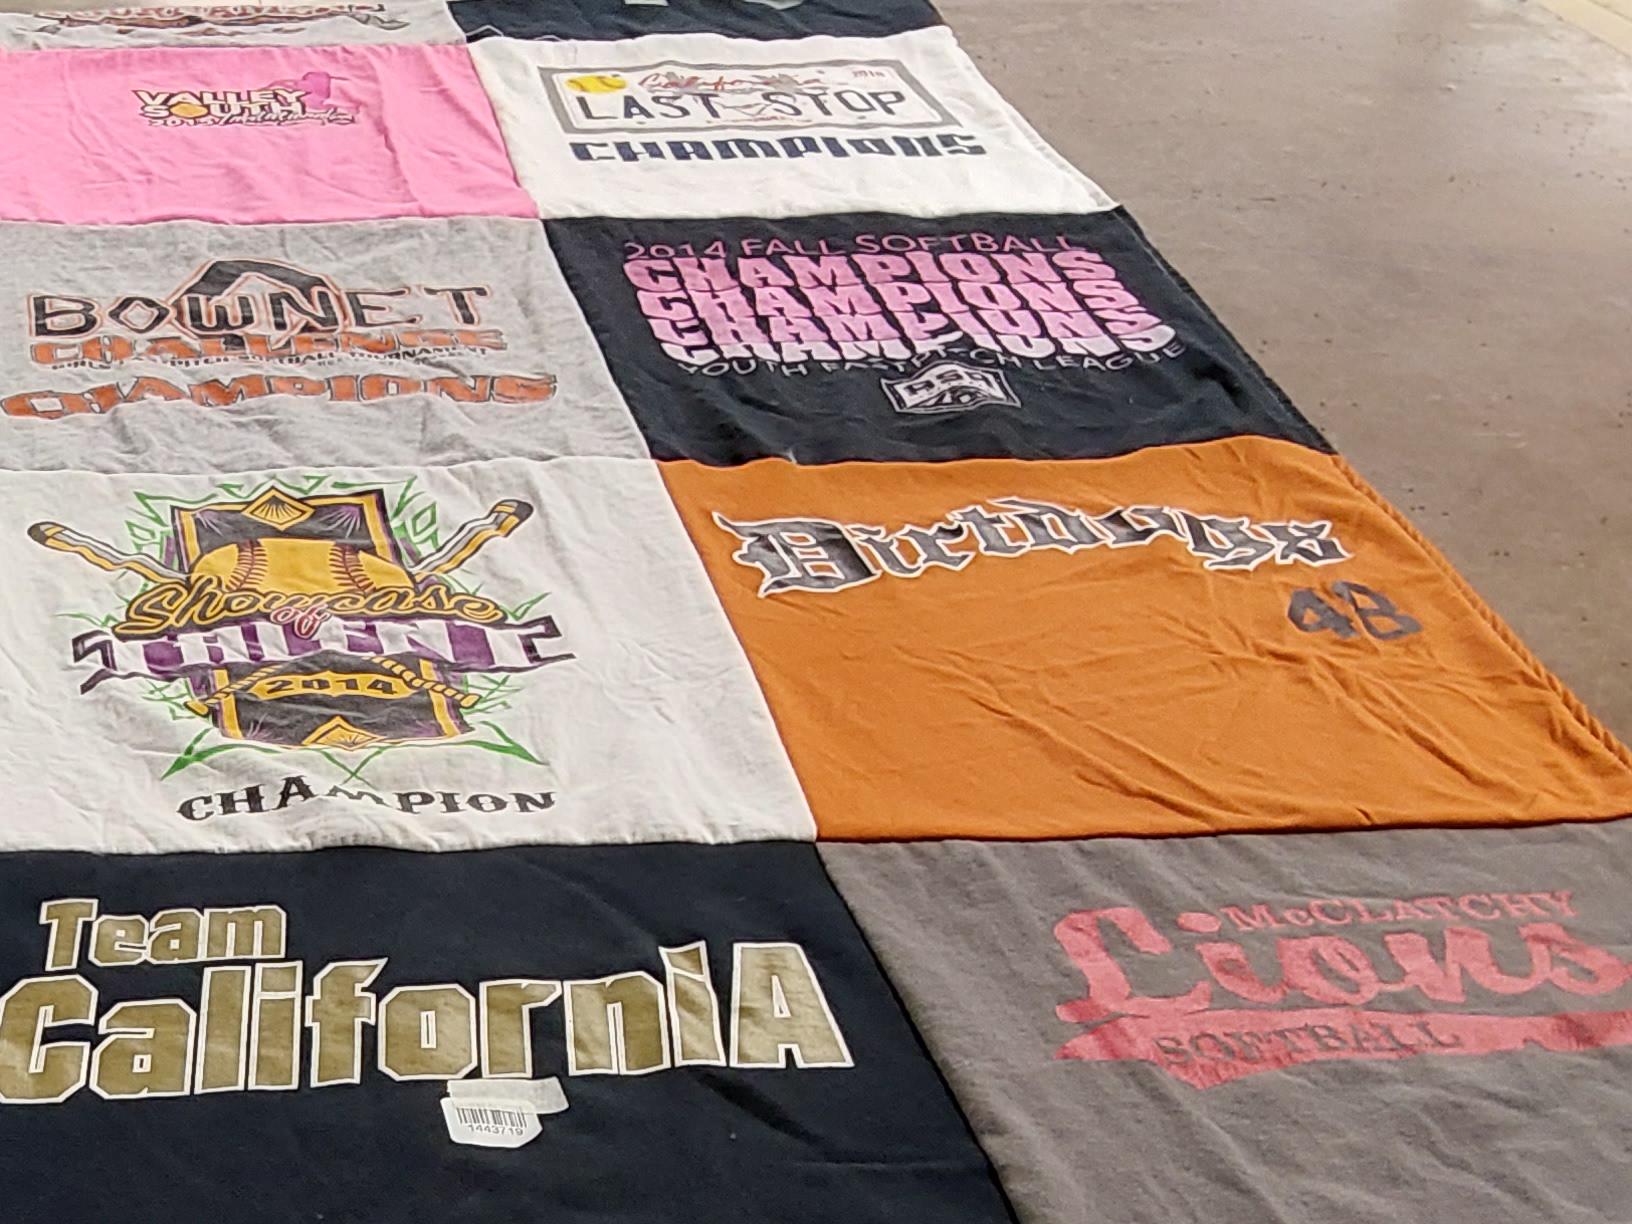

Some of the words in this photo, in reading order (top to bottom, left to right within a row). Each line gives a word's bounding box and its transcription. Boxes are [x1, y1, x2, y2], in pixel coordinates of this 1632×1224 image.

[132, 90, 309, 105] VALLEY
[575, 92, 720, 121] LAST
[764, 90, 909, 117] STOP
[569, 133, 988, 162] CHAMPIONS
[624, 240, 726, 259] 2014
[741, 237, 846, 257] FALL
[855, 232, 1086, 254] SOFTBALL
[623, 250, 1116, 292] CHAMPIONS
[29, 284, 492, 338] BOWNET
[637, 280, 1139, 320] CHAMPIONS
[1032, 341, 1186, 371] LEAGUE
[111, 571, 508, 641] Showcase
[270, 603, 339, 641] of
[1286, 580, 1424, 643] 48
[263, 678, 401, 698] 2014
[176, 774, 558, 823] CHAMPION
[1219, 889, 1582, 933] McCLATCHY
[39, 898, 287, 972] Team
[1054, 906, 1632, 1023] Lions
[1155, 1020, 1464, 1067] SOFTBALL
